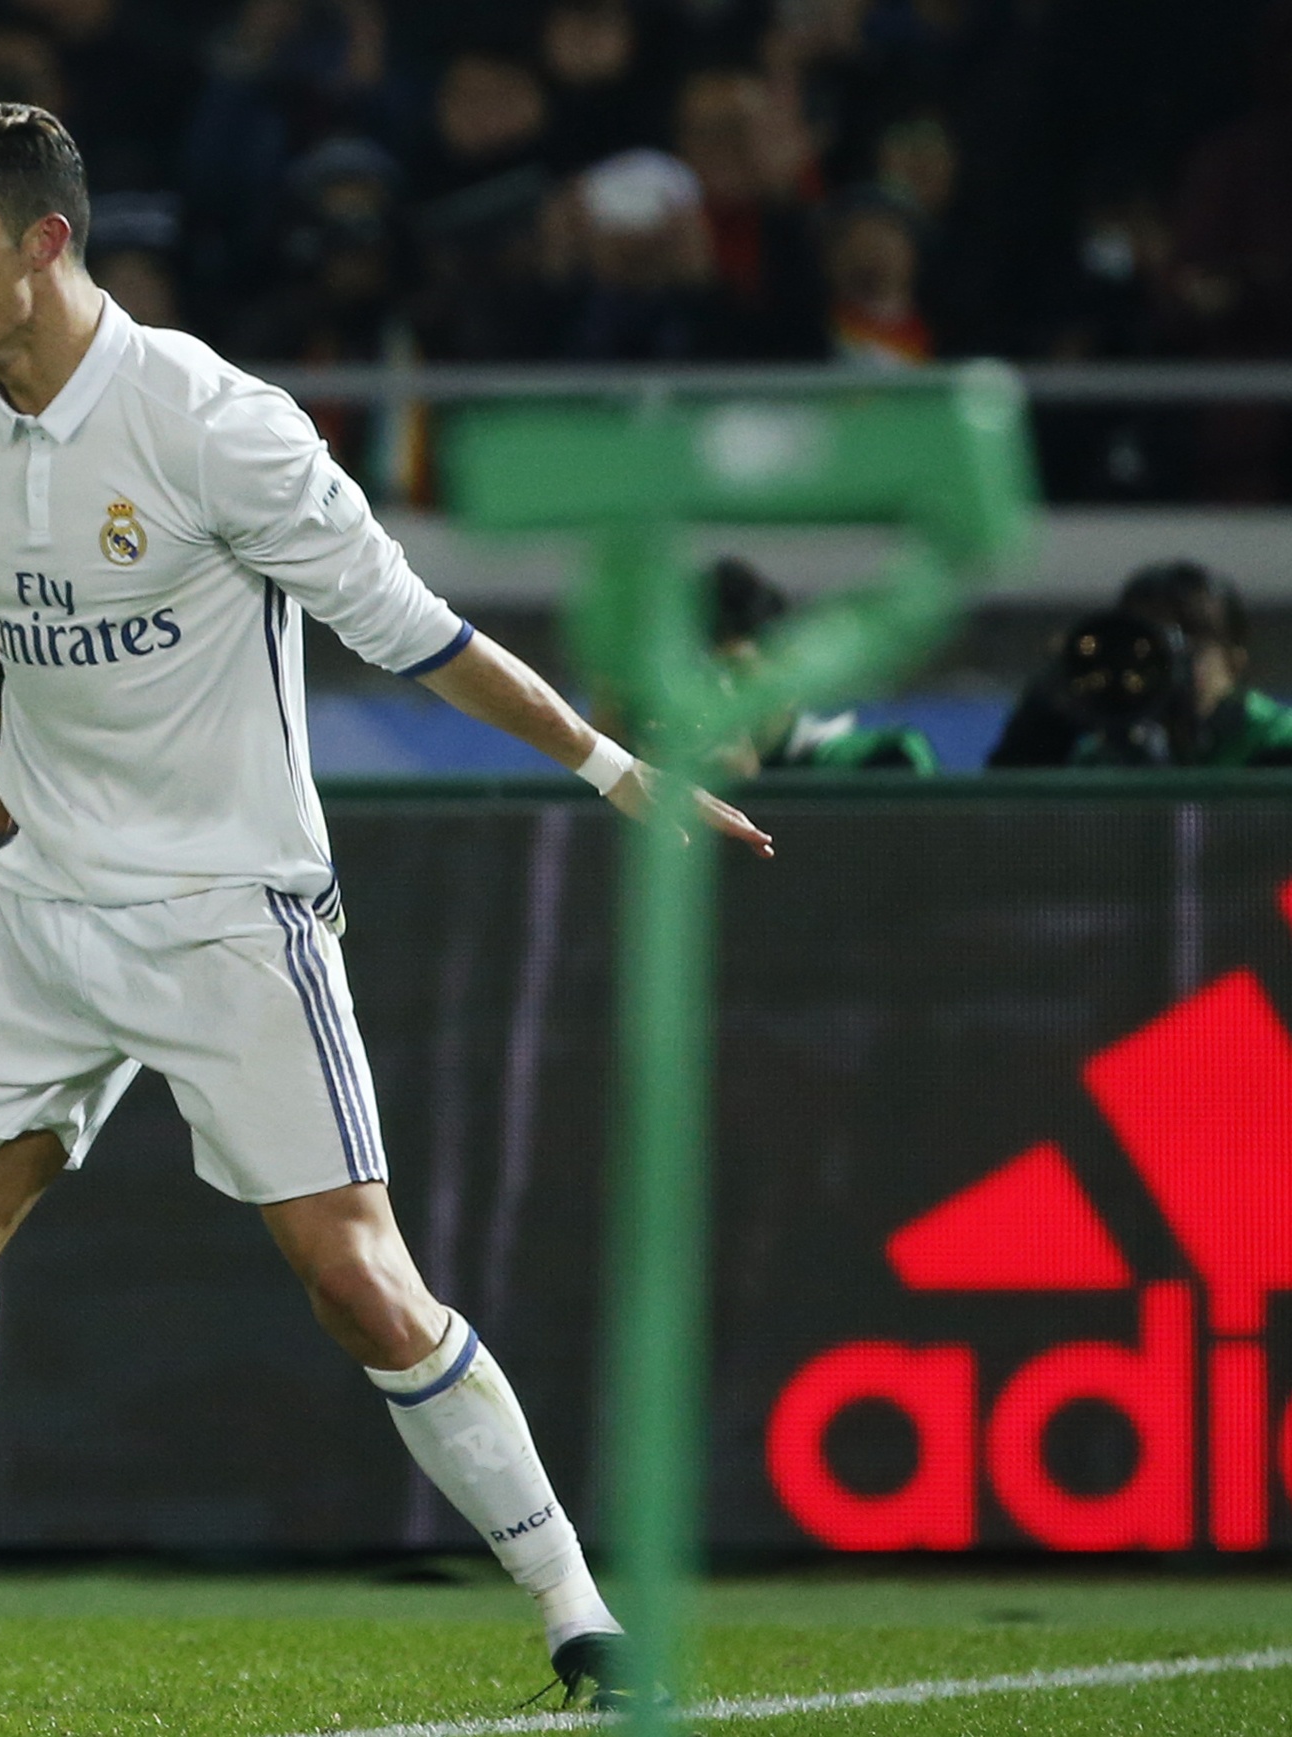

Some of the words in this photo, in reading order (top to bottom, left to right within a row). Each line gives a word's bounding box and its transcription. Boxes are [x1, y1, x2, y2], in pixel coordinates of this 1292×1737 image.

[15, 572, 74, 616] Fly
[765, 1278, 1292, 1551] adi
[490, 1502, 556, 1543] RMCF
